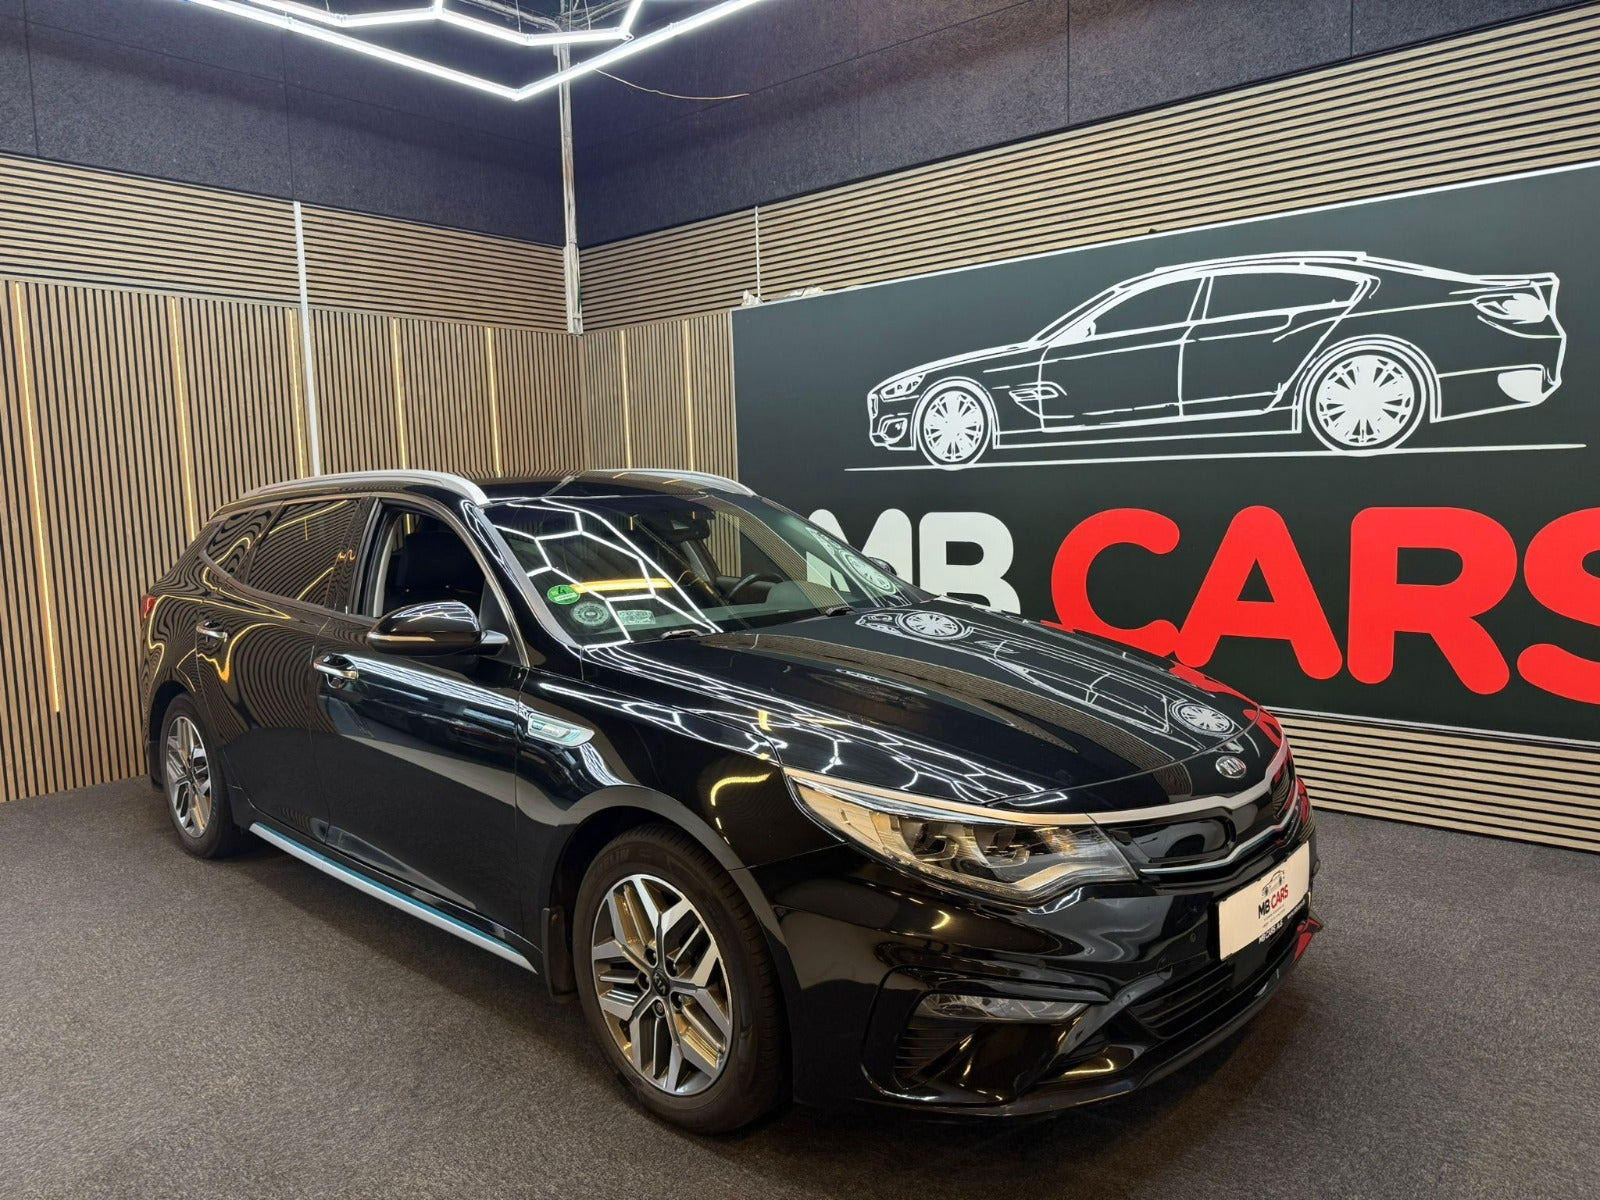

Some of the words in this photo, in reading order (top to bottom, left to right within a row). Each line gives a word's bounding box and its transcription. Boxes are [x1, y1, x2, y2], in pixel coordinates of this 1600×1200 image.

[1051, 505, 1600, 704] CARS
[1258, 898, 1270, 919] MB
[1271, 884, 1288, 908] CARS
[653, 972, 666, 995] KIA
